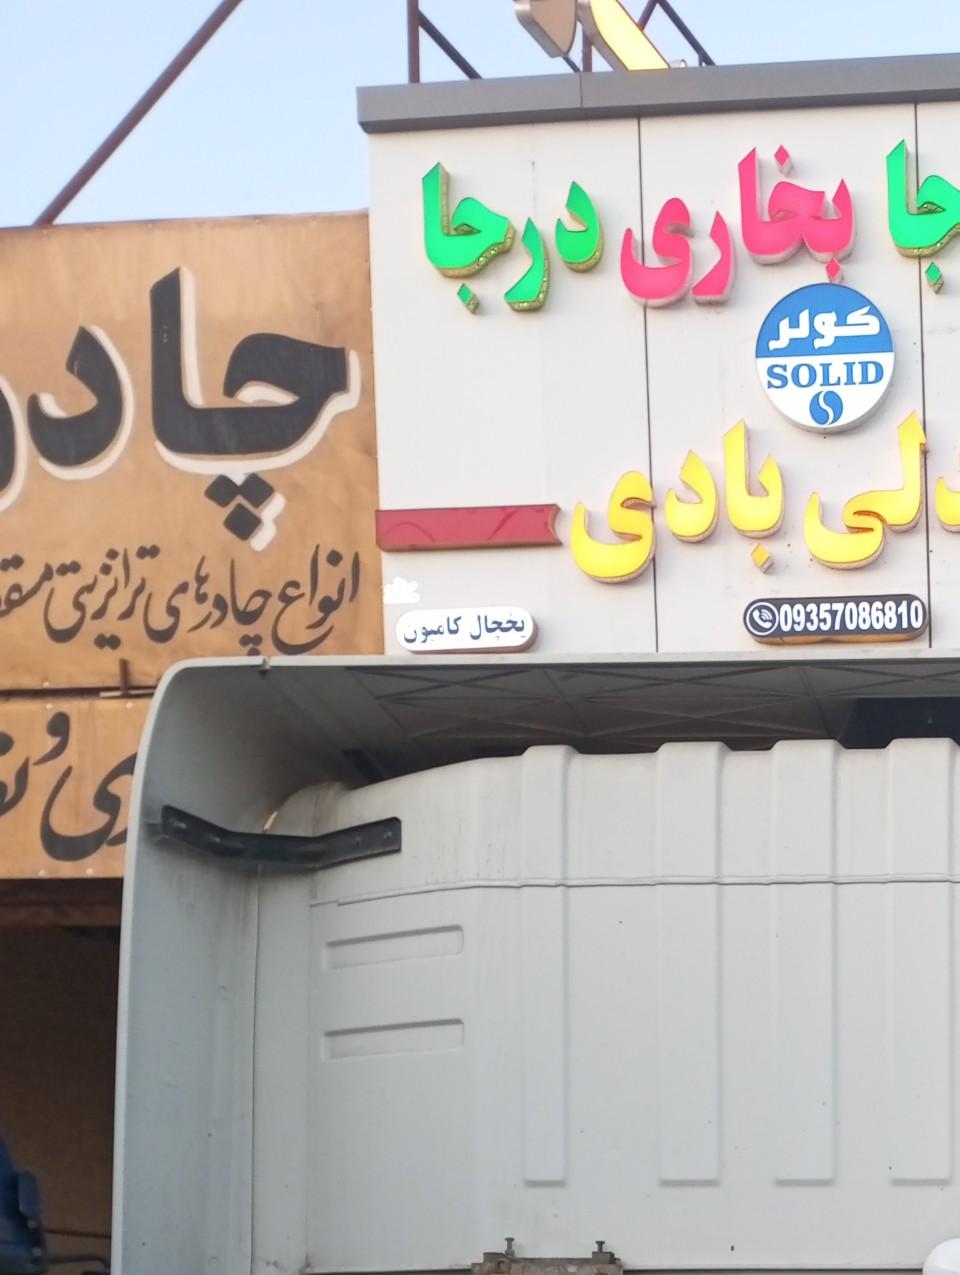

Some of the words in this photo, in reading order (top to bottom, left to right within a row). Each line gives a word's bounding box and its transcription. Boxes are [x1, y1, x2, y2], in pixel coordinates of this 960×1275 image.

[422, 163, 601, 308] درجا
[621, 146, 856, 301] بخاری
[766, 361, 884, 389] SOLID
[768, 306, 881, 351] کولر
[570, 423, 784, 580] بادی
[43, 545, 160, 650] ترانزیتی
[271, 544, 360, 655] انواع
[779, 601, 923, 632] 09357086810
